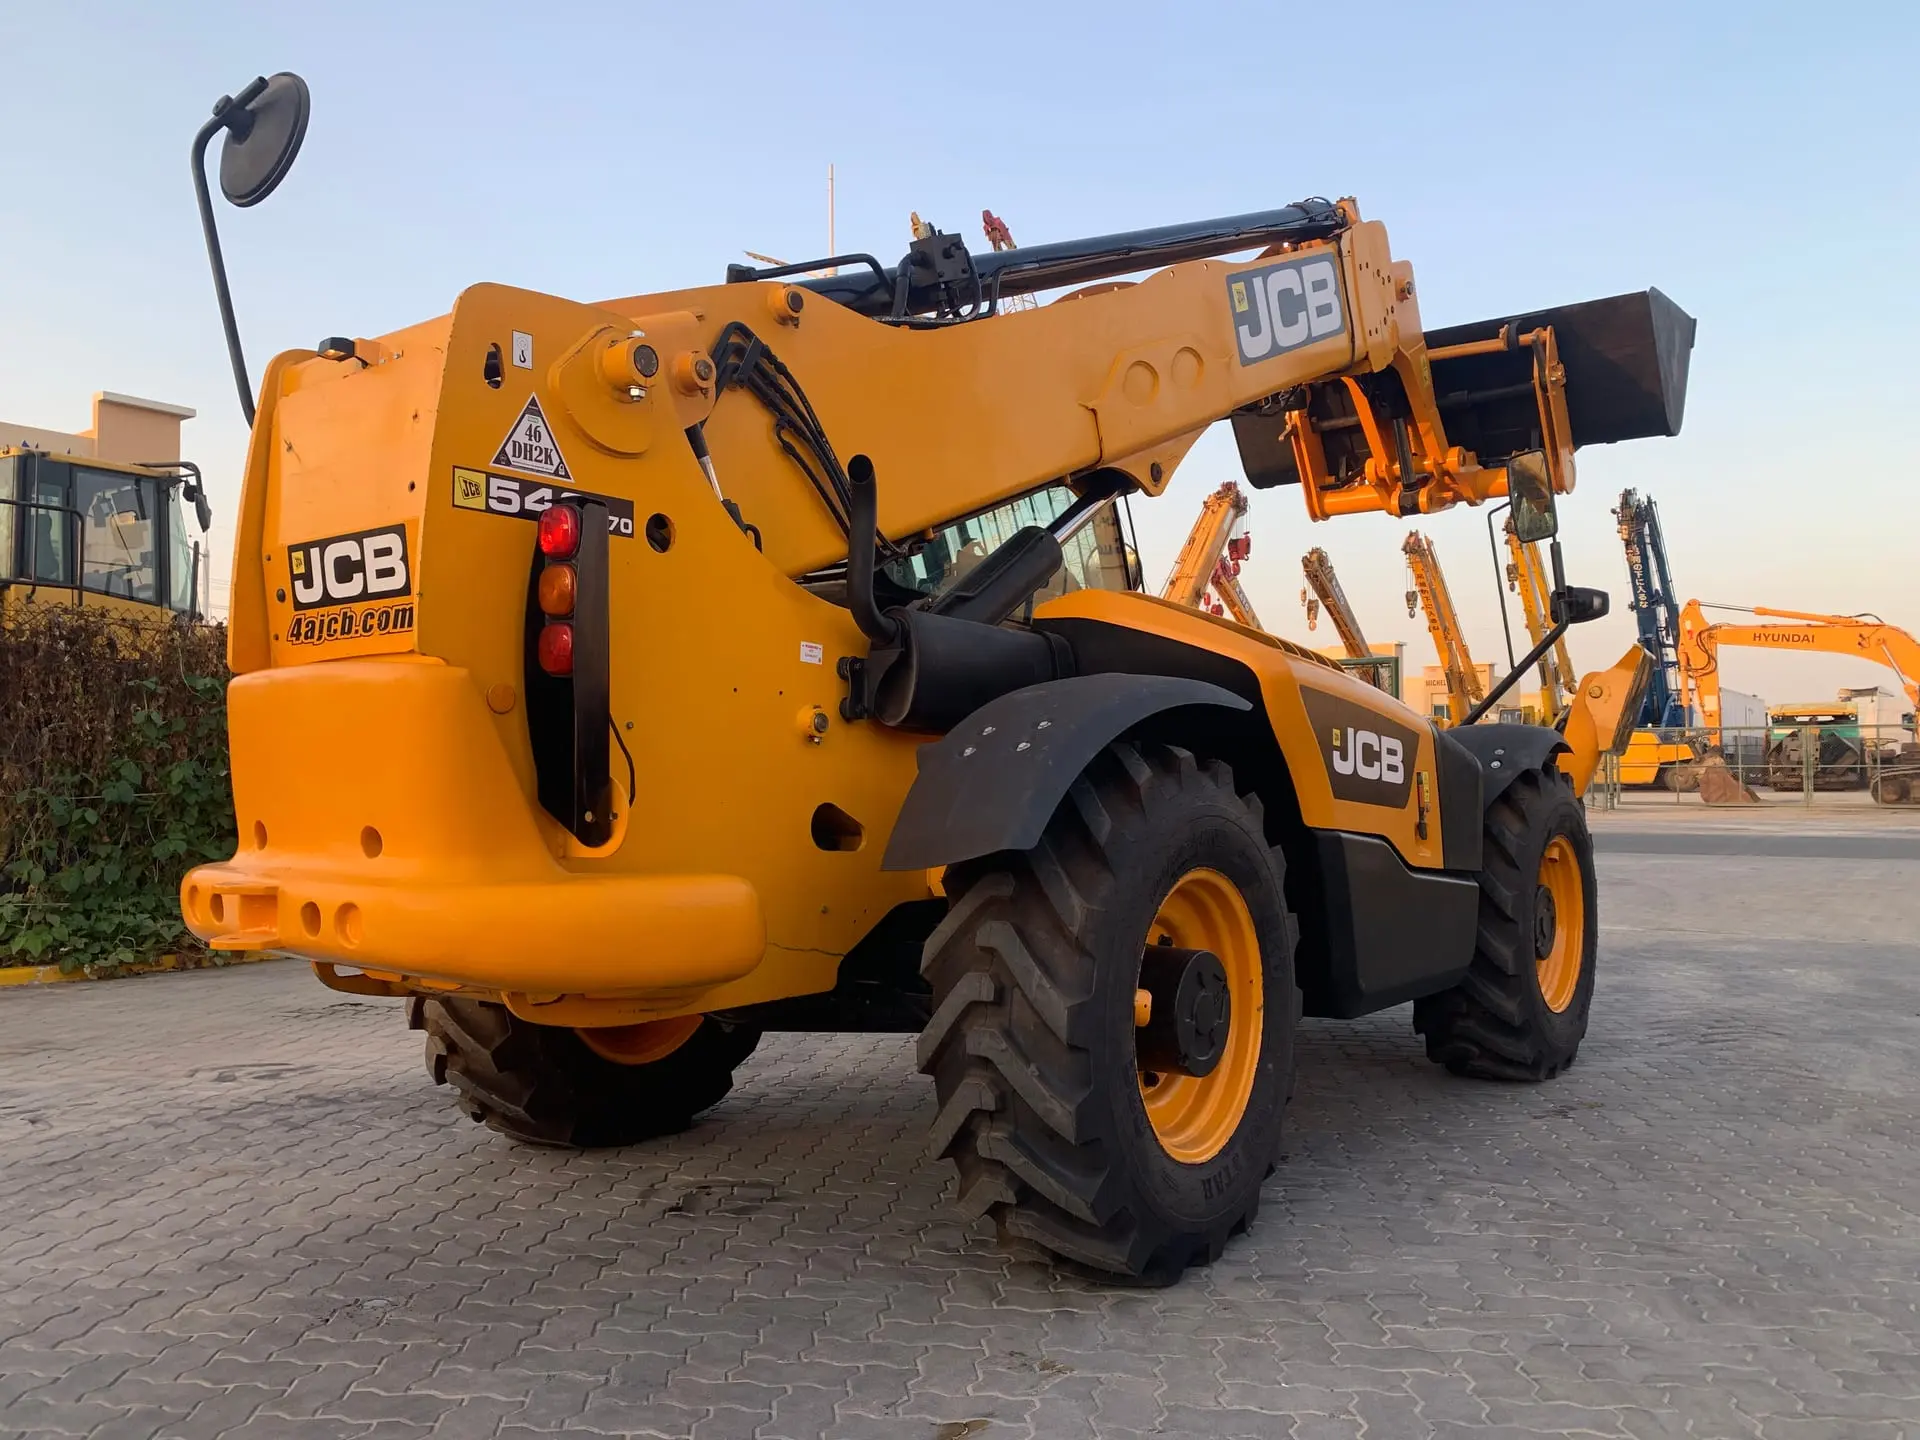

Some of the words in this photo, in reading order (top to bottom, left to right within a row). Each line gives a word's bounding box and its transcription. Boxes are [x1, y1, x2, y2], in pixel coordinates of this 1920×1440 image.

[1238, 261, 1342, 358] JCB
[525, 424, 542, 443] 46
[511, 440, 554, 466] DH2K
[462, 479, 482, 498] JCB
[488, 476, 584, 514] 54
[294, 533, 407, 604] JCB
[288, 603, 414, 646] 4ajcb.com
[1753, 632, 1815, 644] HYUNDAI
[1332, 727, 1405, 785] JCB
